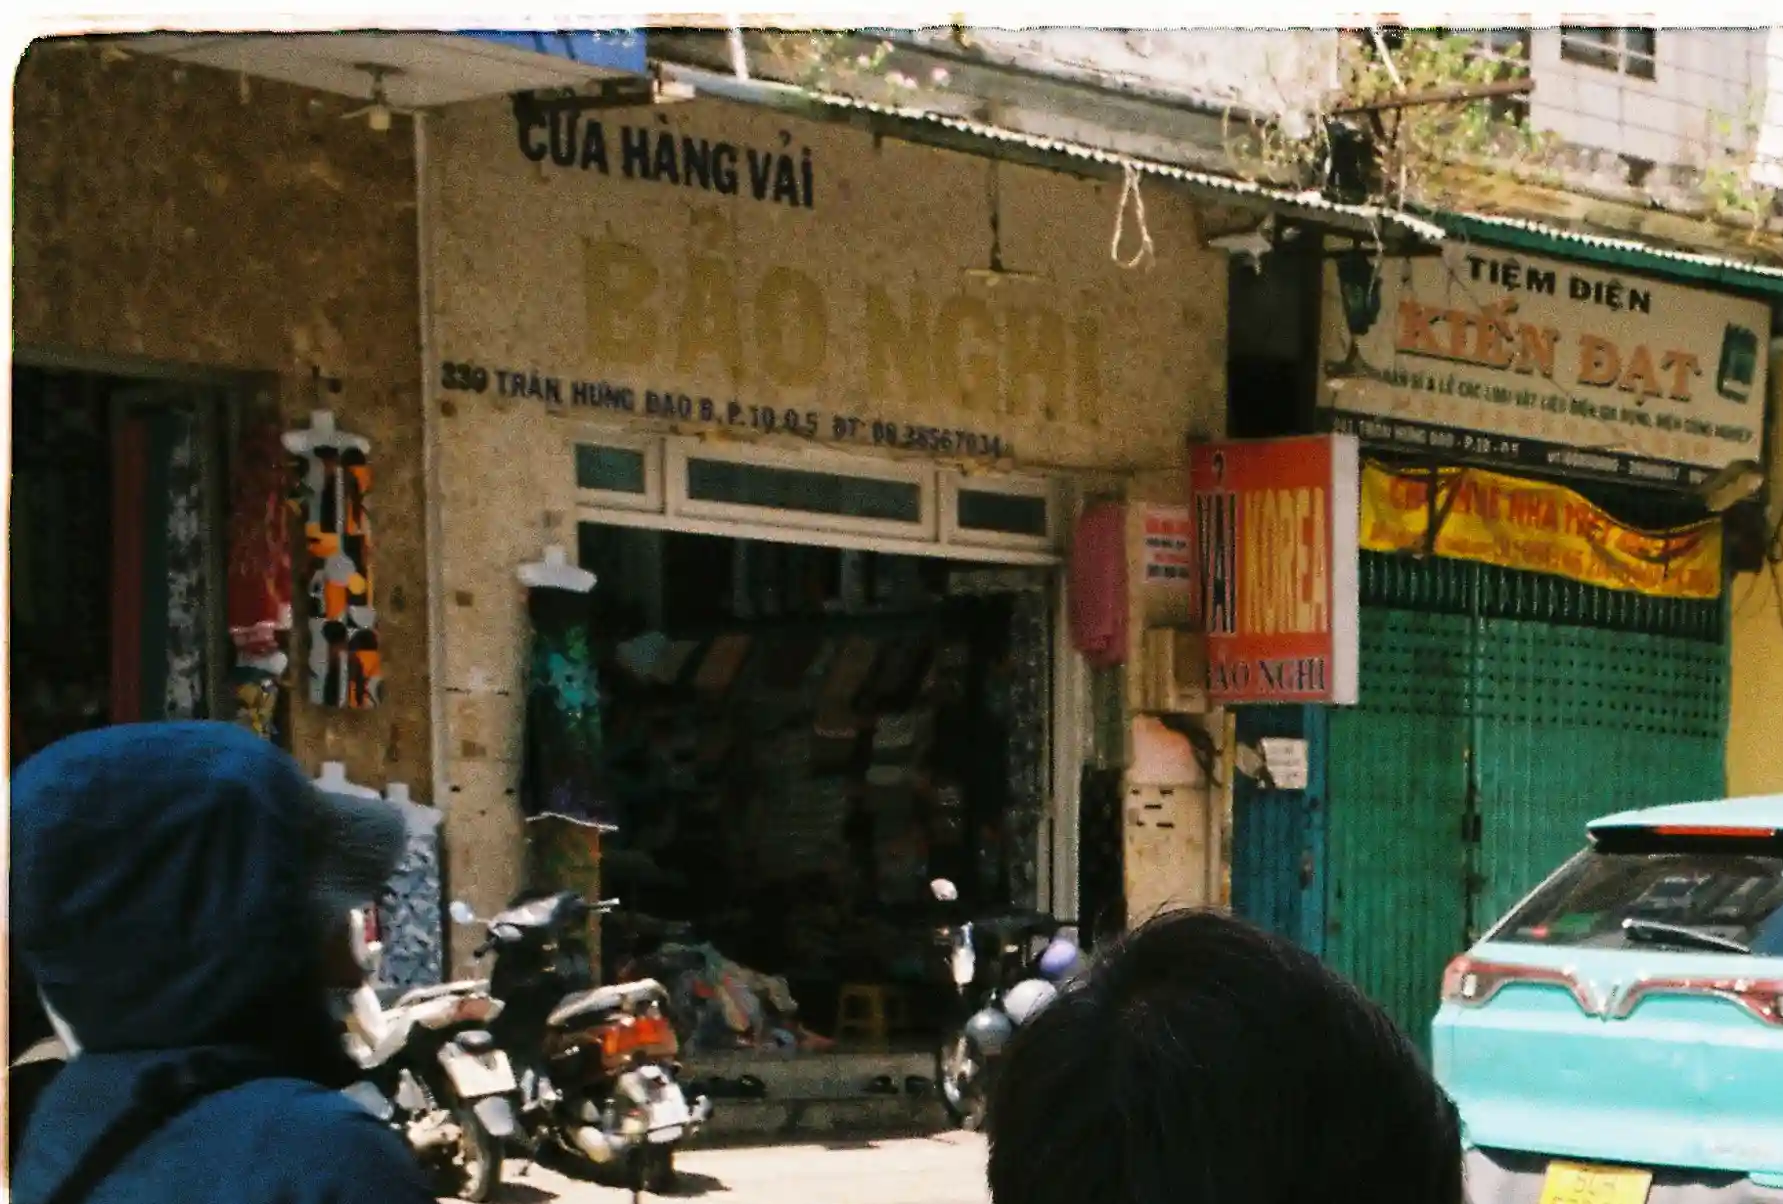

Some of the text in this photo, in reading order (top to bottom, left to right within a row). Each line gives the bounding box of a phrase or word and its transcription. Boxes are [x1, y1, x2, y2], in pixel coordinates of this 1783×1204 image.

[620, 112, 738, 196] HÀNG
[748, 128, 814, 209] VẢI
[1467, 254, 1556, 296] TIỆM
